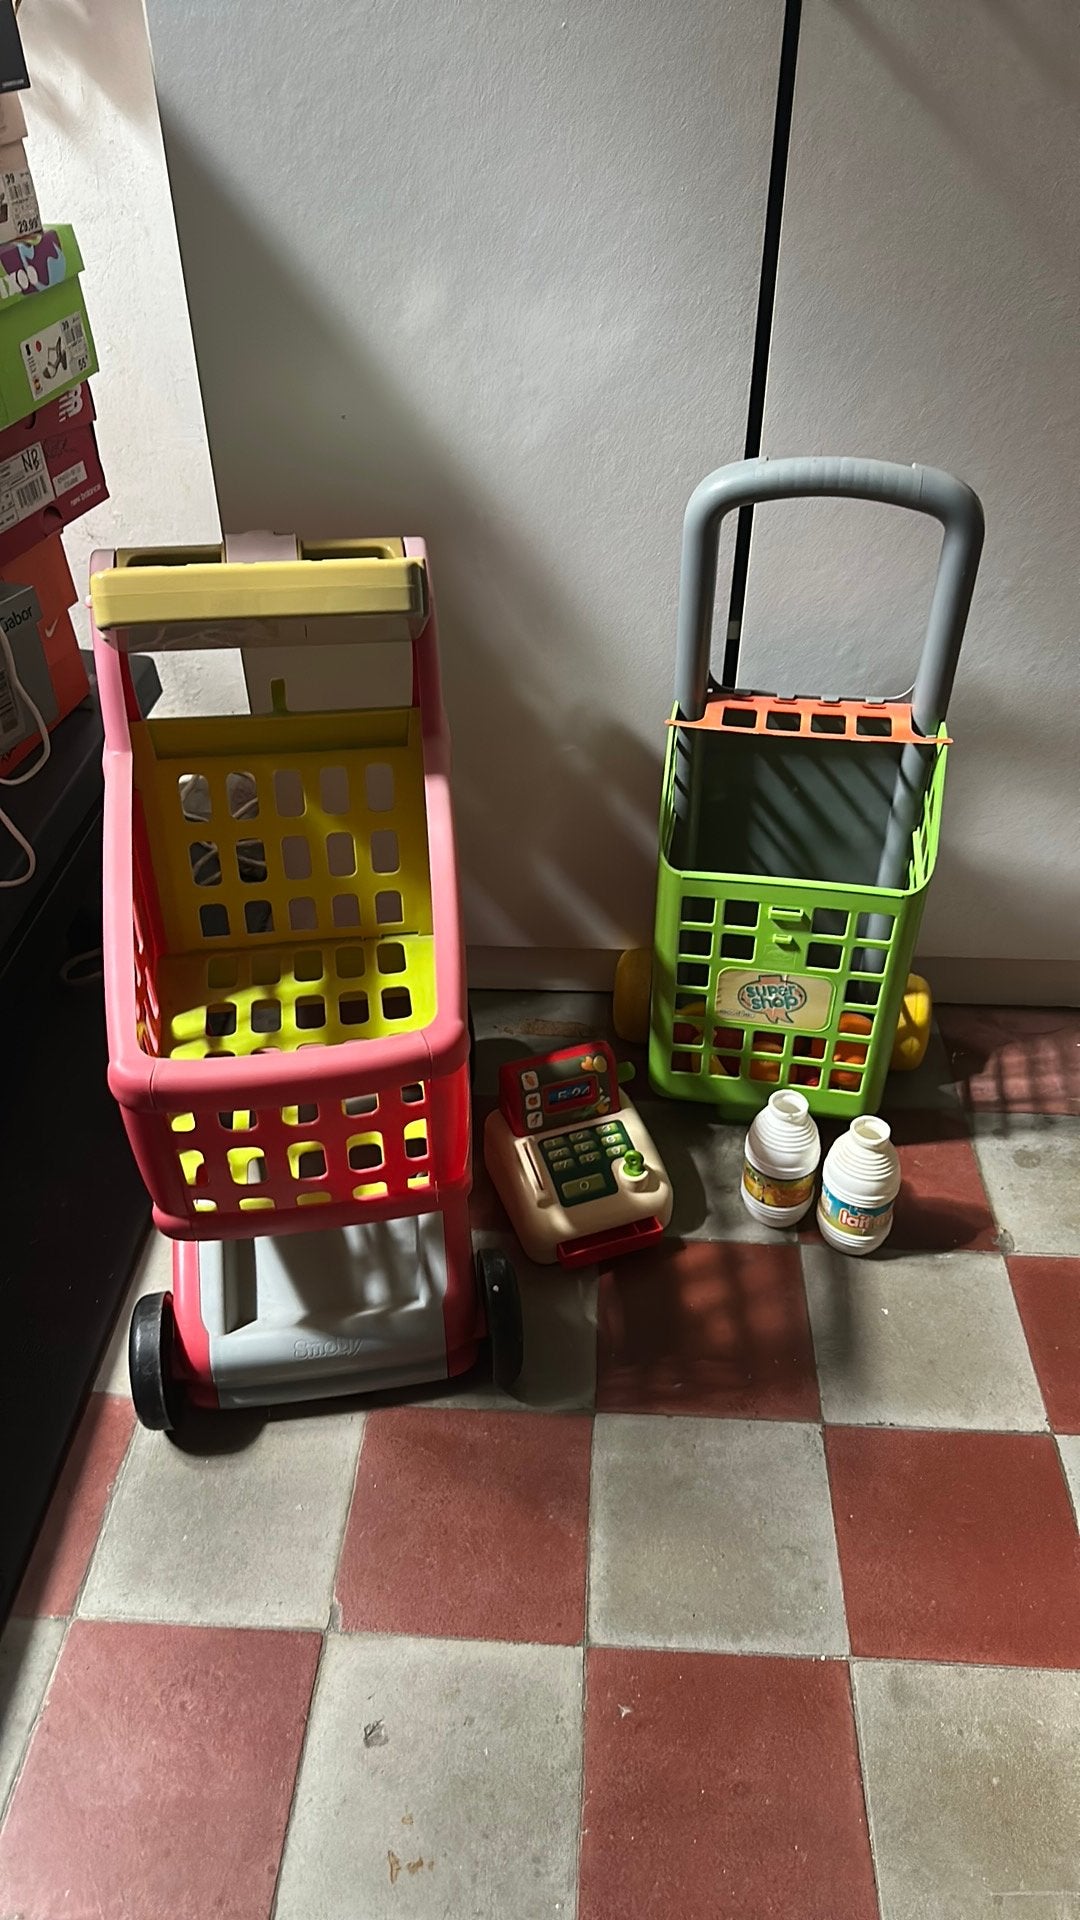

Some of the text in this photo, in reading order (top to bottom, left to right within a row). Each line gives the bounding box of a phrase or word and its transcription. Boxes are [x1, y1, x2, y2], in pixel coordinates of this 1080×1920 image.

[21, 448, 40, 473] NB
[0, 605, 33, 633] Gabor
[745, 984, 799, 1010] super shop
[293, 1337, 363, 1361] Smoby
